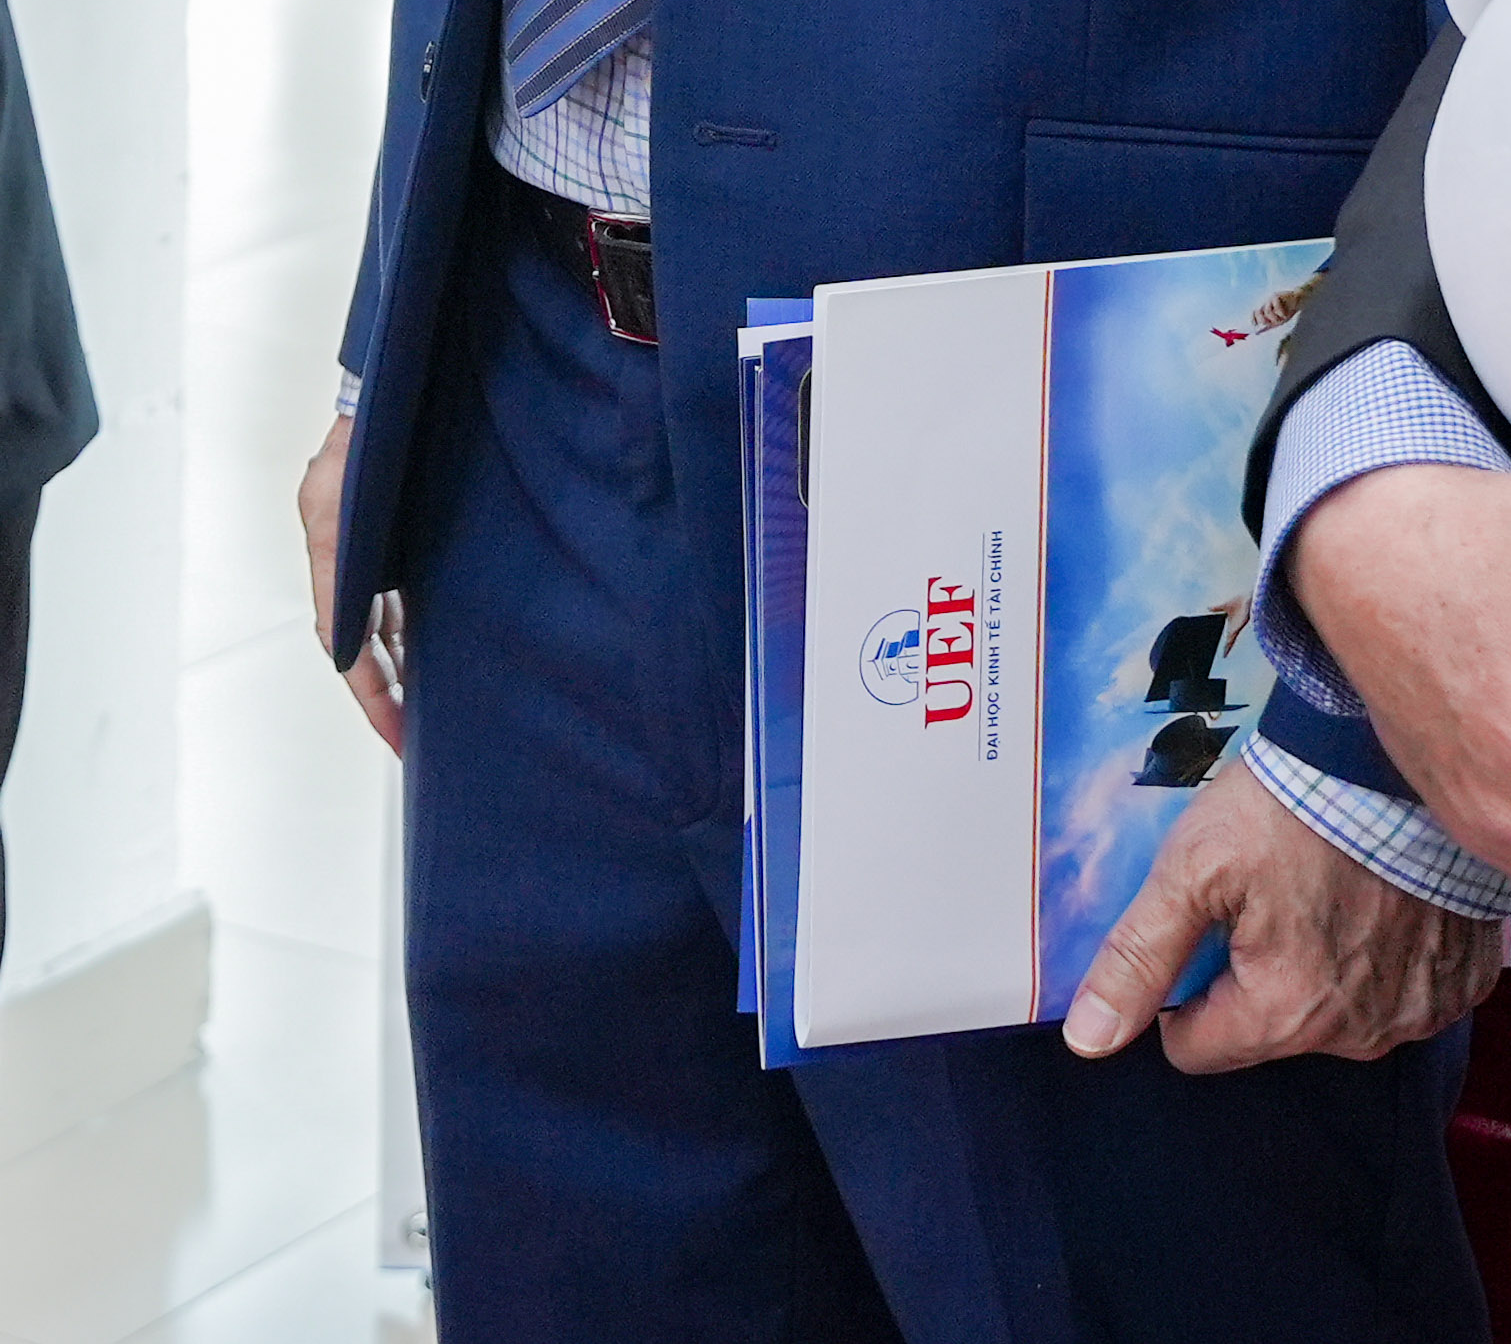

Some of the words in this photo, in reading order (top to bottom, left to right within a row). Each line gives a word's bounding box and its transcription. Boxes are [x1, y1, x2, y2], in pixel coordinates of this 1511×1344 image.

[988, 531, 1003, 582] CHÍNH
[988, 589, 1002, 614] TÀI
[984, 620, 1001, 640] TẾ
[924, 576, 976, 729] UEF
[987, 647, 1000, 685] KINH
[986, 692, 1002, 727] HỌC
[986, 733, 1002, 760] ĐẠI
